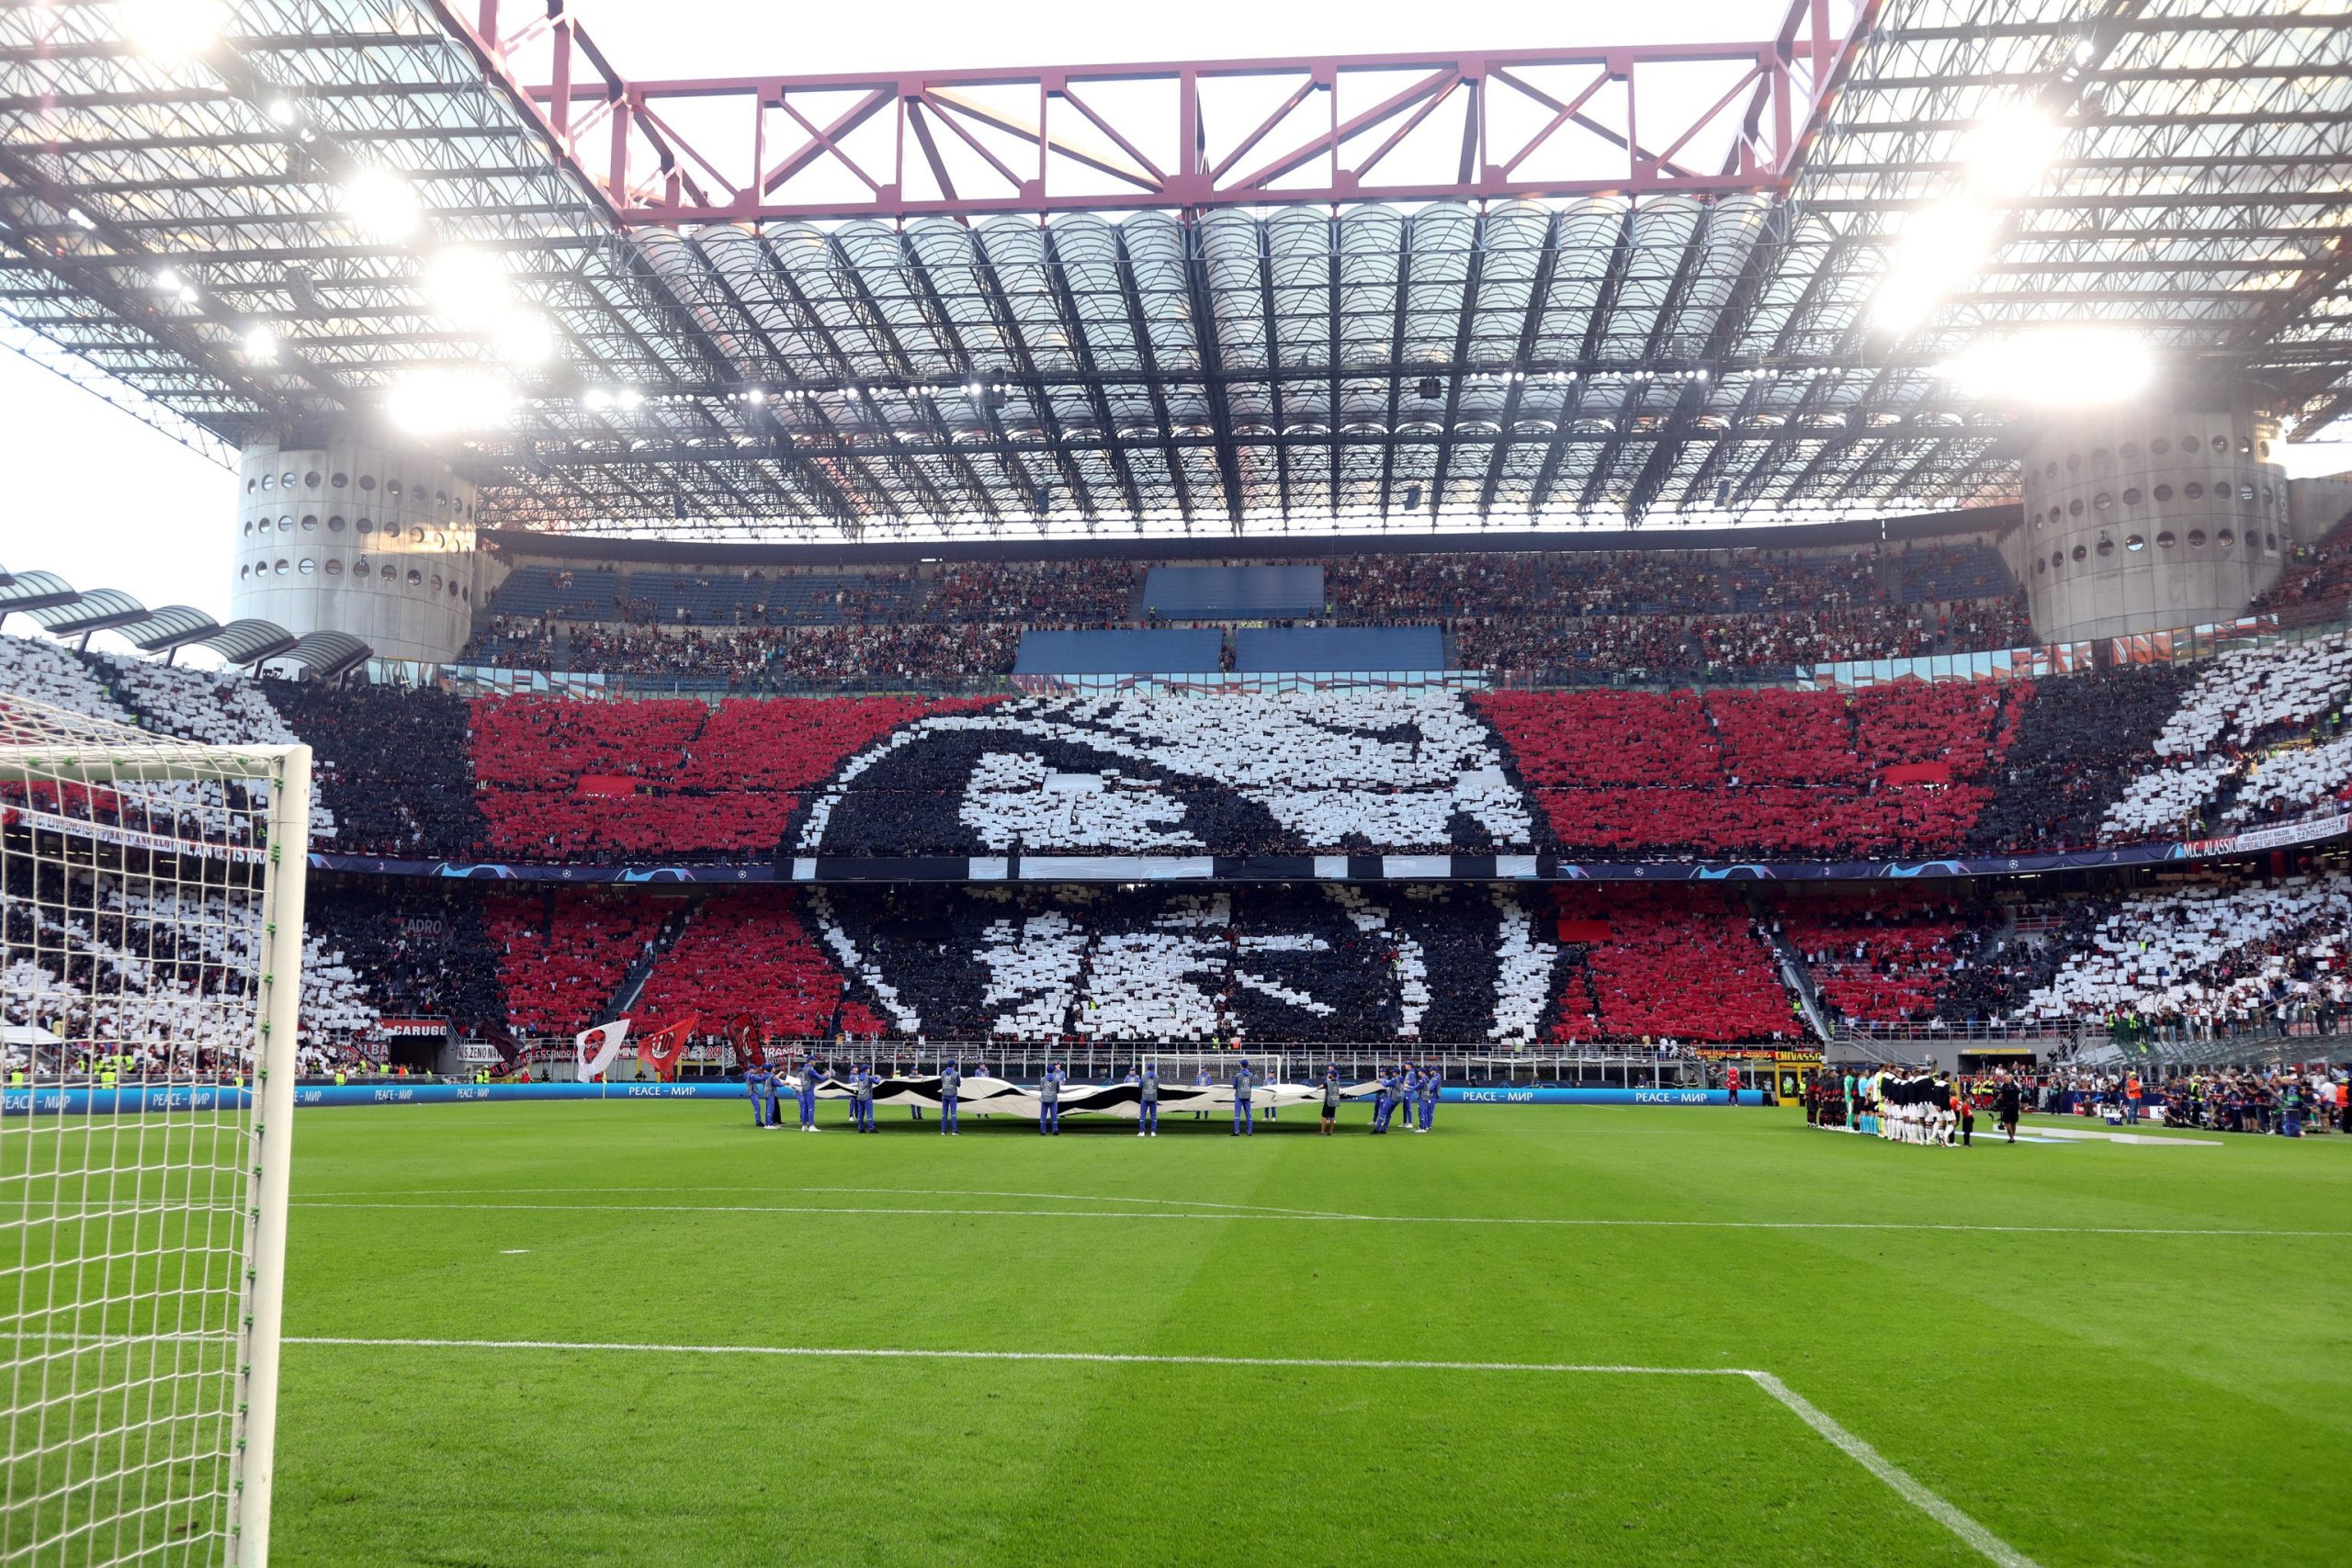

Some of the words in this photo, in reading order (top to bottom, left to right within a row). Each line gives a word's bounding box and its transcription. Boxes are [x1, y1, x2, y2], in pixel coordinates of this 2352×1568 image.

[109, 829, 171, 849] SAT'ANGELO
[2184, 842, 2202, 859] M.C.
[2204, 837, 2237, 856] ALASSIO
[407, 919, 443, 934] ADRO
[393, 1025, 447, 1036] CARUGO
[628, 1087, 661, 1096] PEACE
[1463, 1092, 1498, 1101] PEACE
[1635, 1092, 1670, 1102] PEACE
